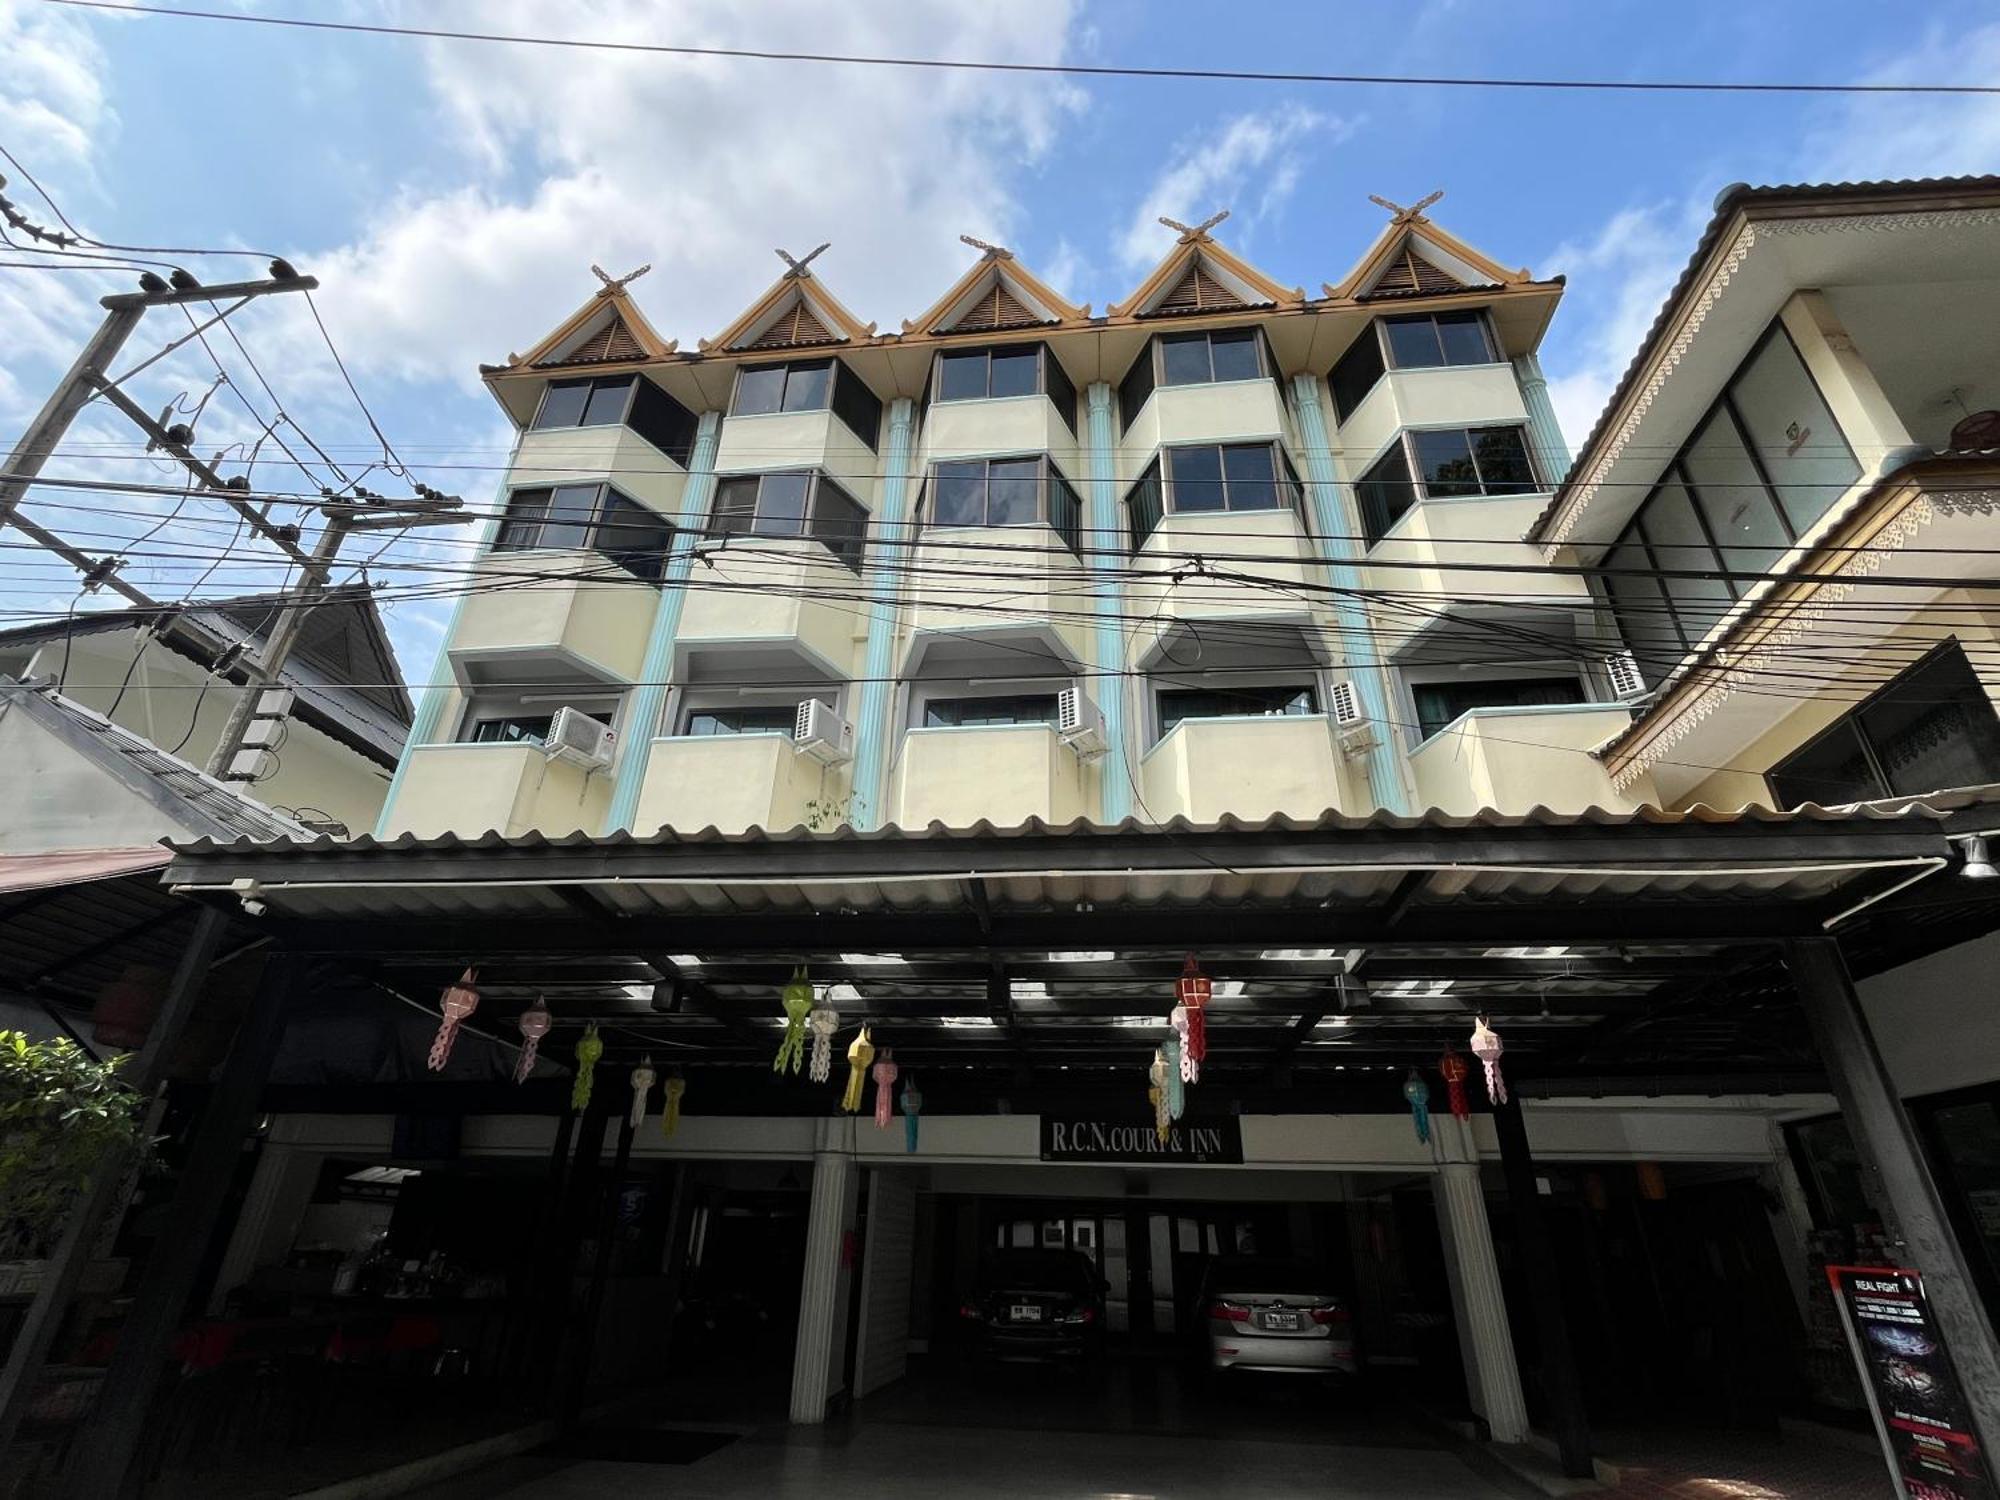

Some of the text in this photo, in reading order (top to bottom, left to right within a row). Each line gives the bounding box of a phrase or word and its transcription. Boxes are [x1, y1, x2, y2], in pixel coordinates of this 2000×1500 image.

[1171, 1128, 1183, 1153] &
[1189, 1128, 1222, 1153] INN
[1855, 1280, 1900, 1294] REAL FIGHT
